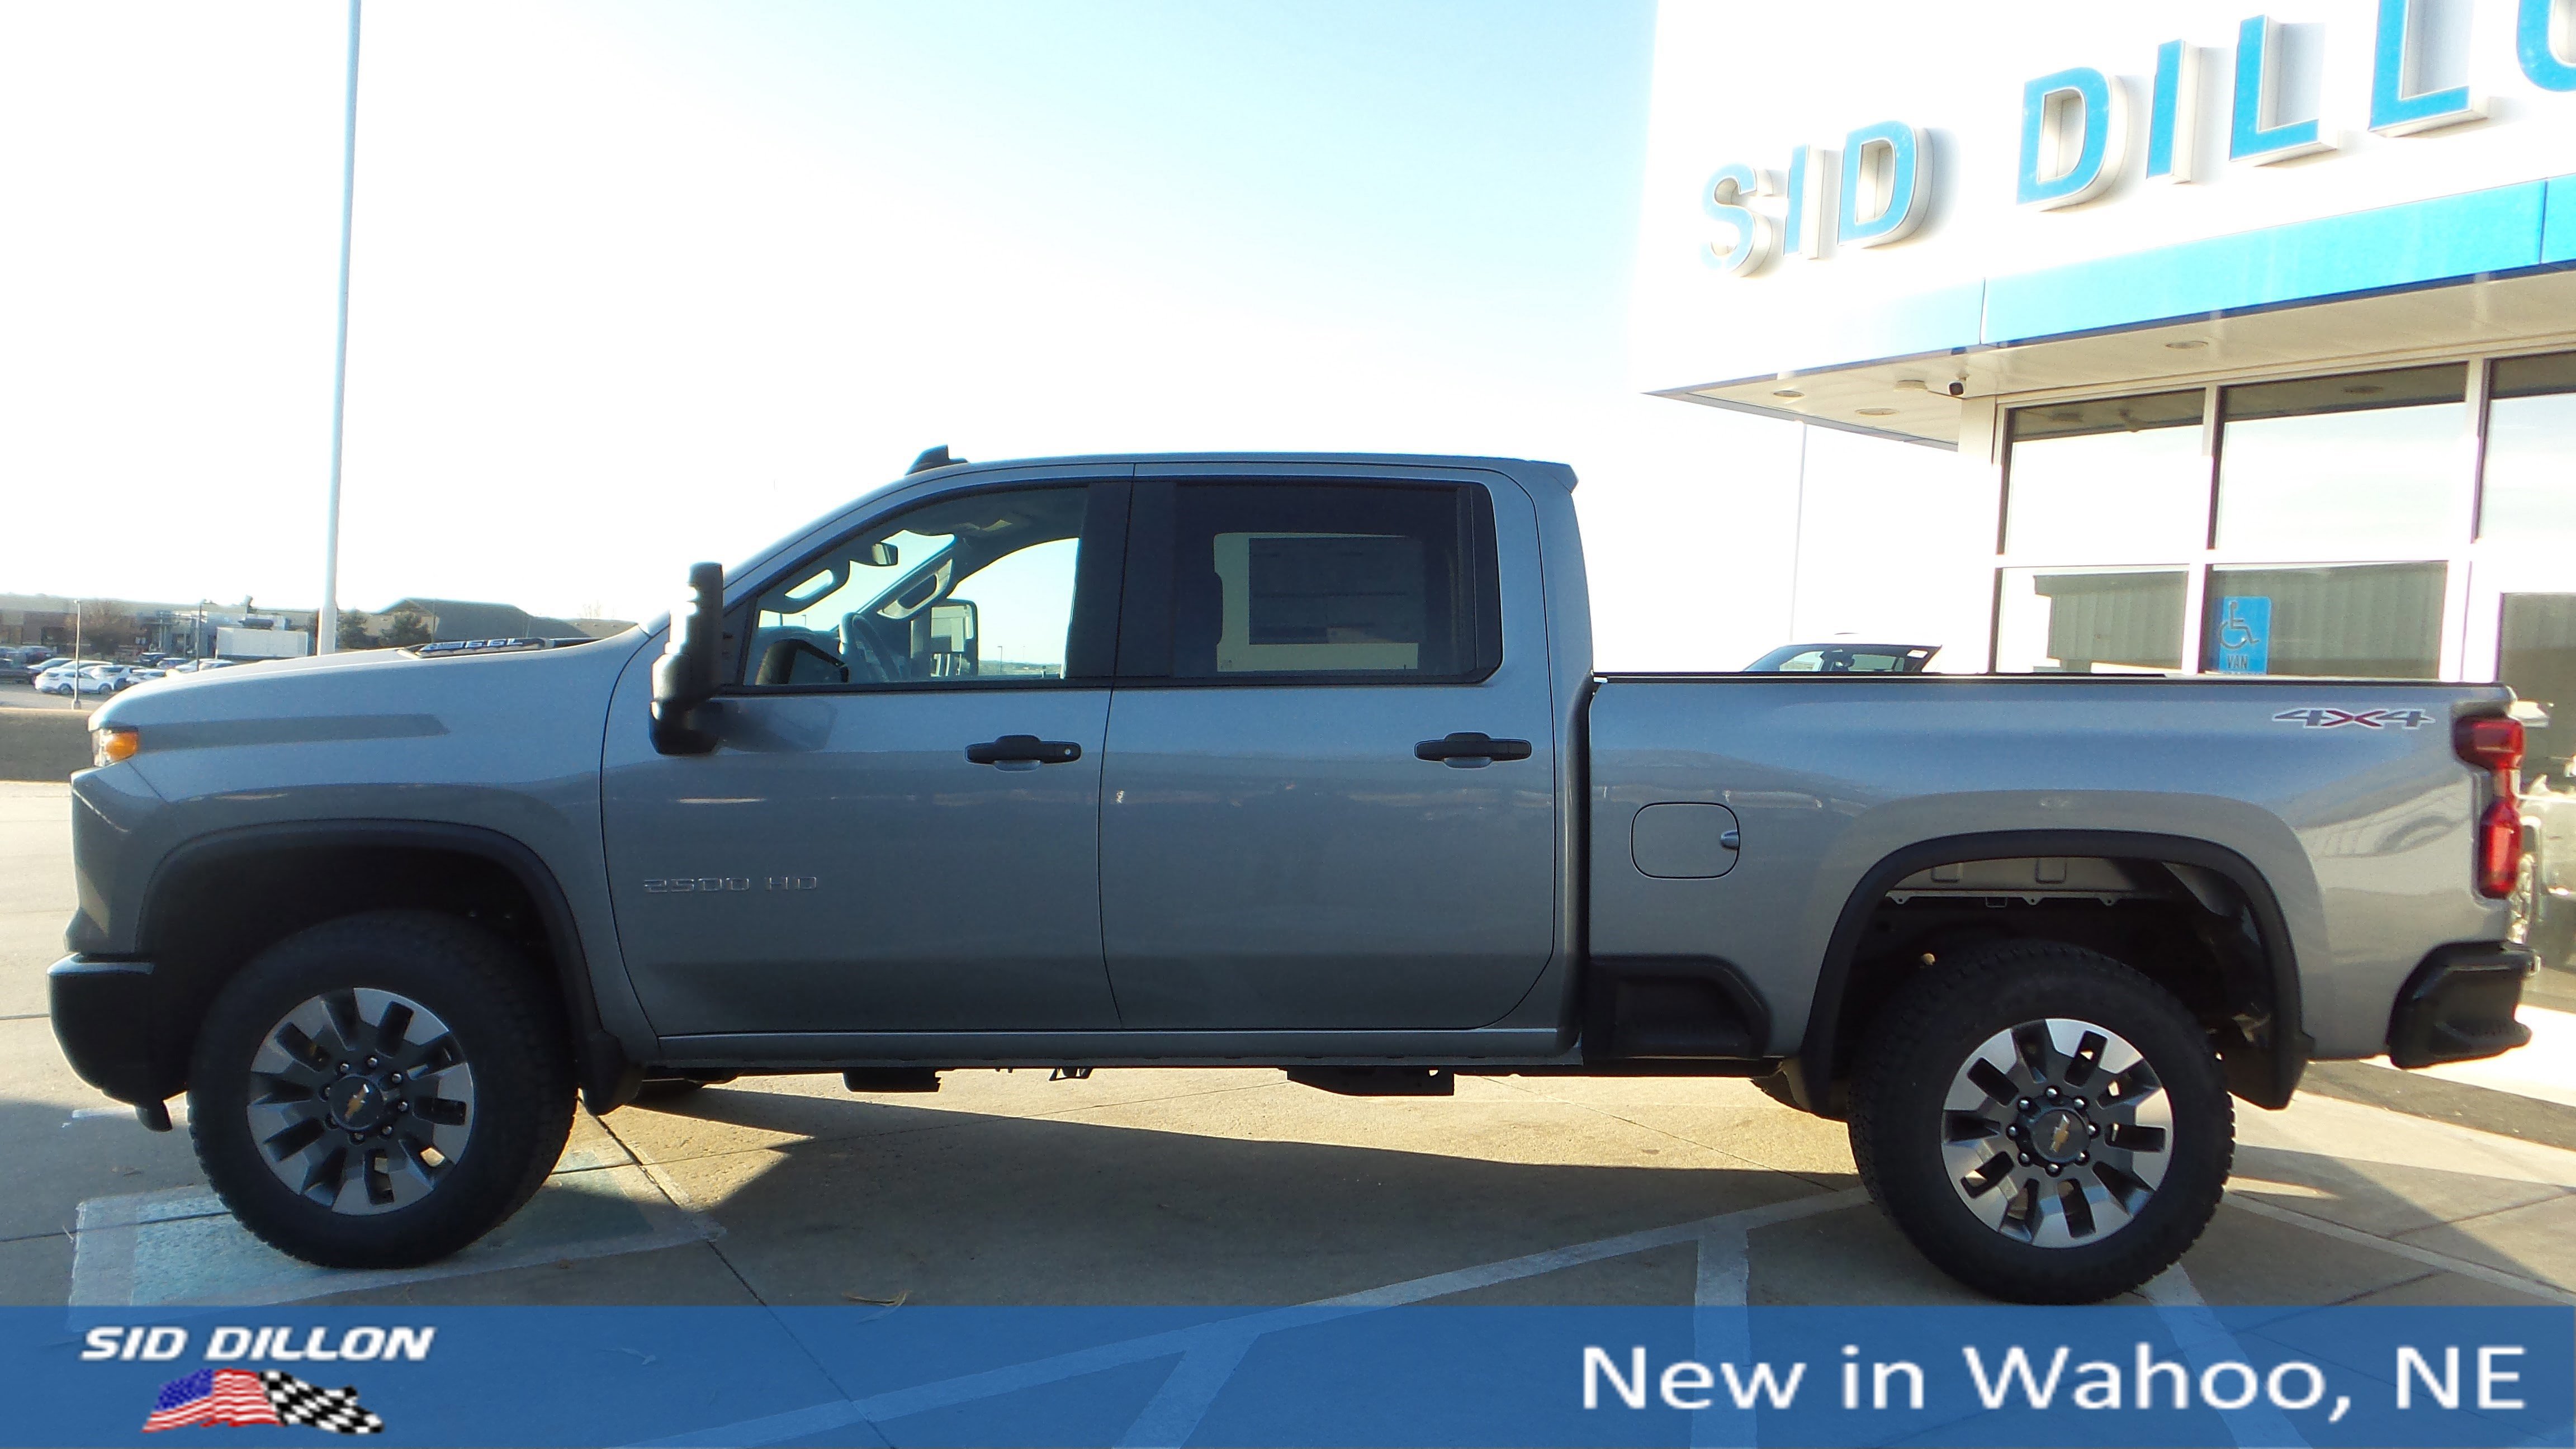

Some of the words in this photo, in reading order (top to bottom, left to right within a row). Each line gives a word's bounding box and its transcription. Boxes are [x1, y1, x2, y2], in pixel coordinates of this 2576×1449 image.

[1699, 120, 1933, 276] SID
[2227, 655, 2248, 670] VAN
[644, 878, 750, 893] 2500
[765, 877, 817, 891] HD
